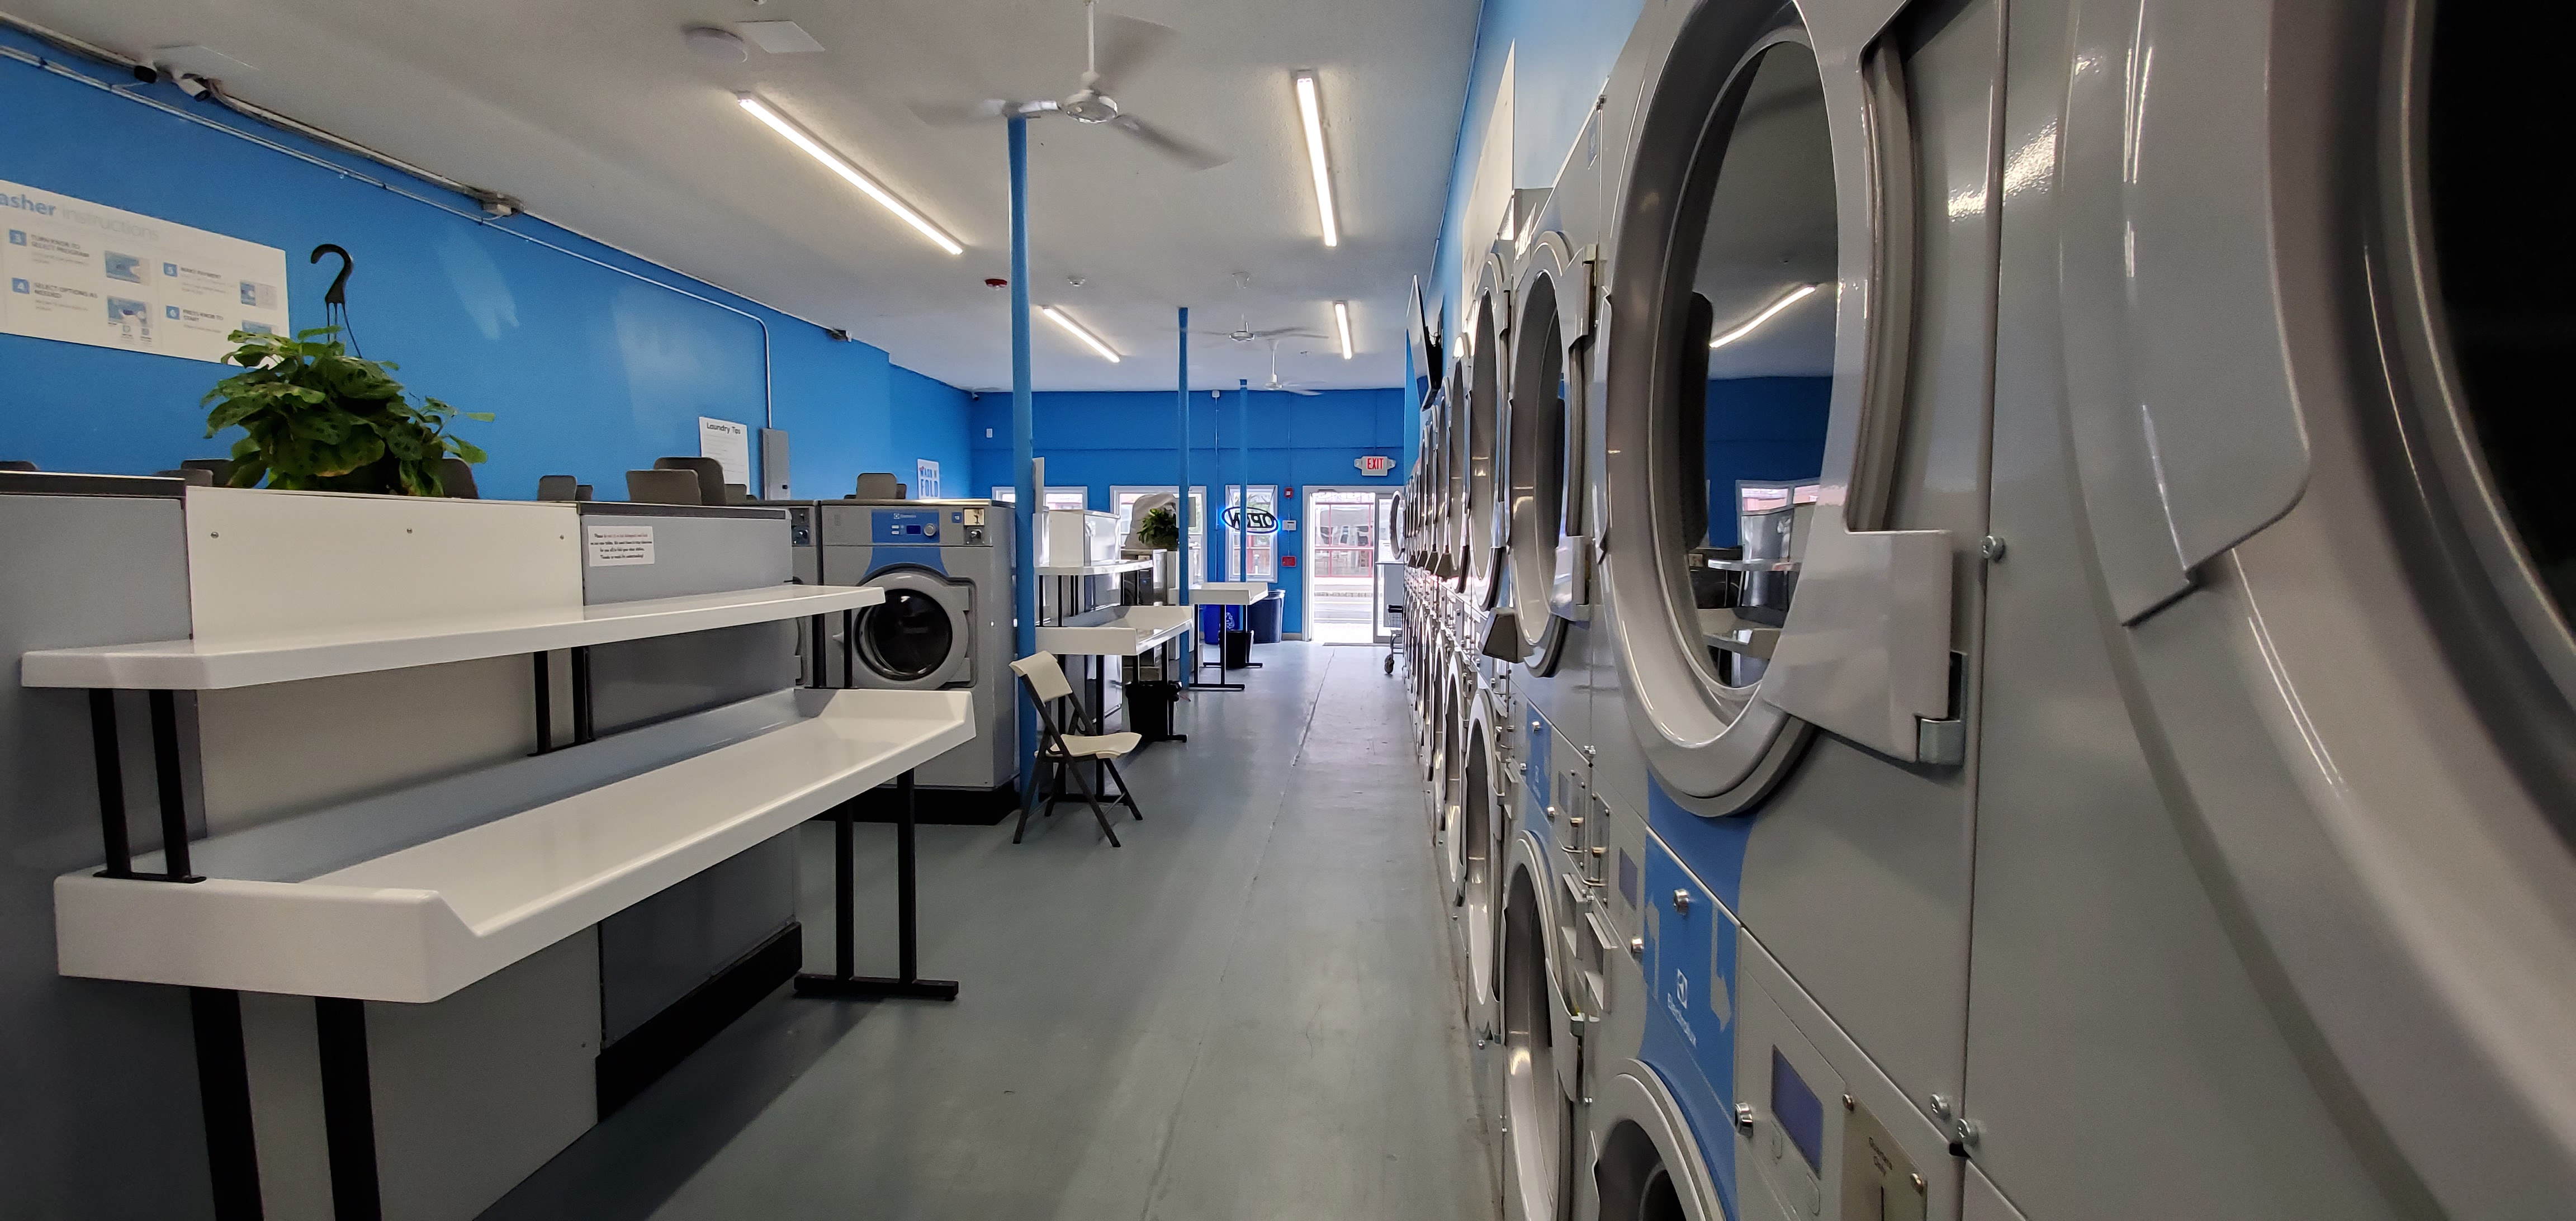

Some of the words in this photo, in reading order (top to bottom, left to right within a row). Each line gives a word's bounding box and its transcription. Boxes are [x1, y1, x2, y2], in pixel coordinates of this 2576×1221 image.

[707, 422, 730, 434] Laundry
[732, 426, 741, 434] Tips
[1367, 458, 1384, 470] EXIT
[921, 479, 938, 498] FOLD
